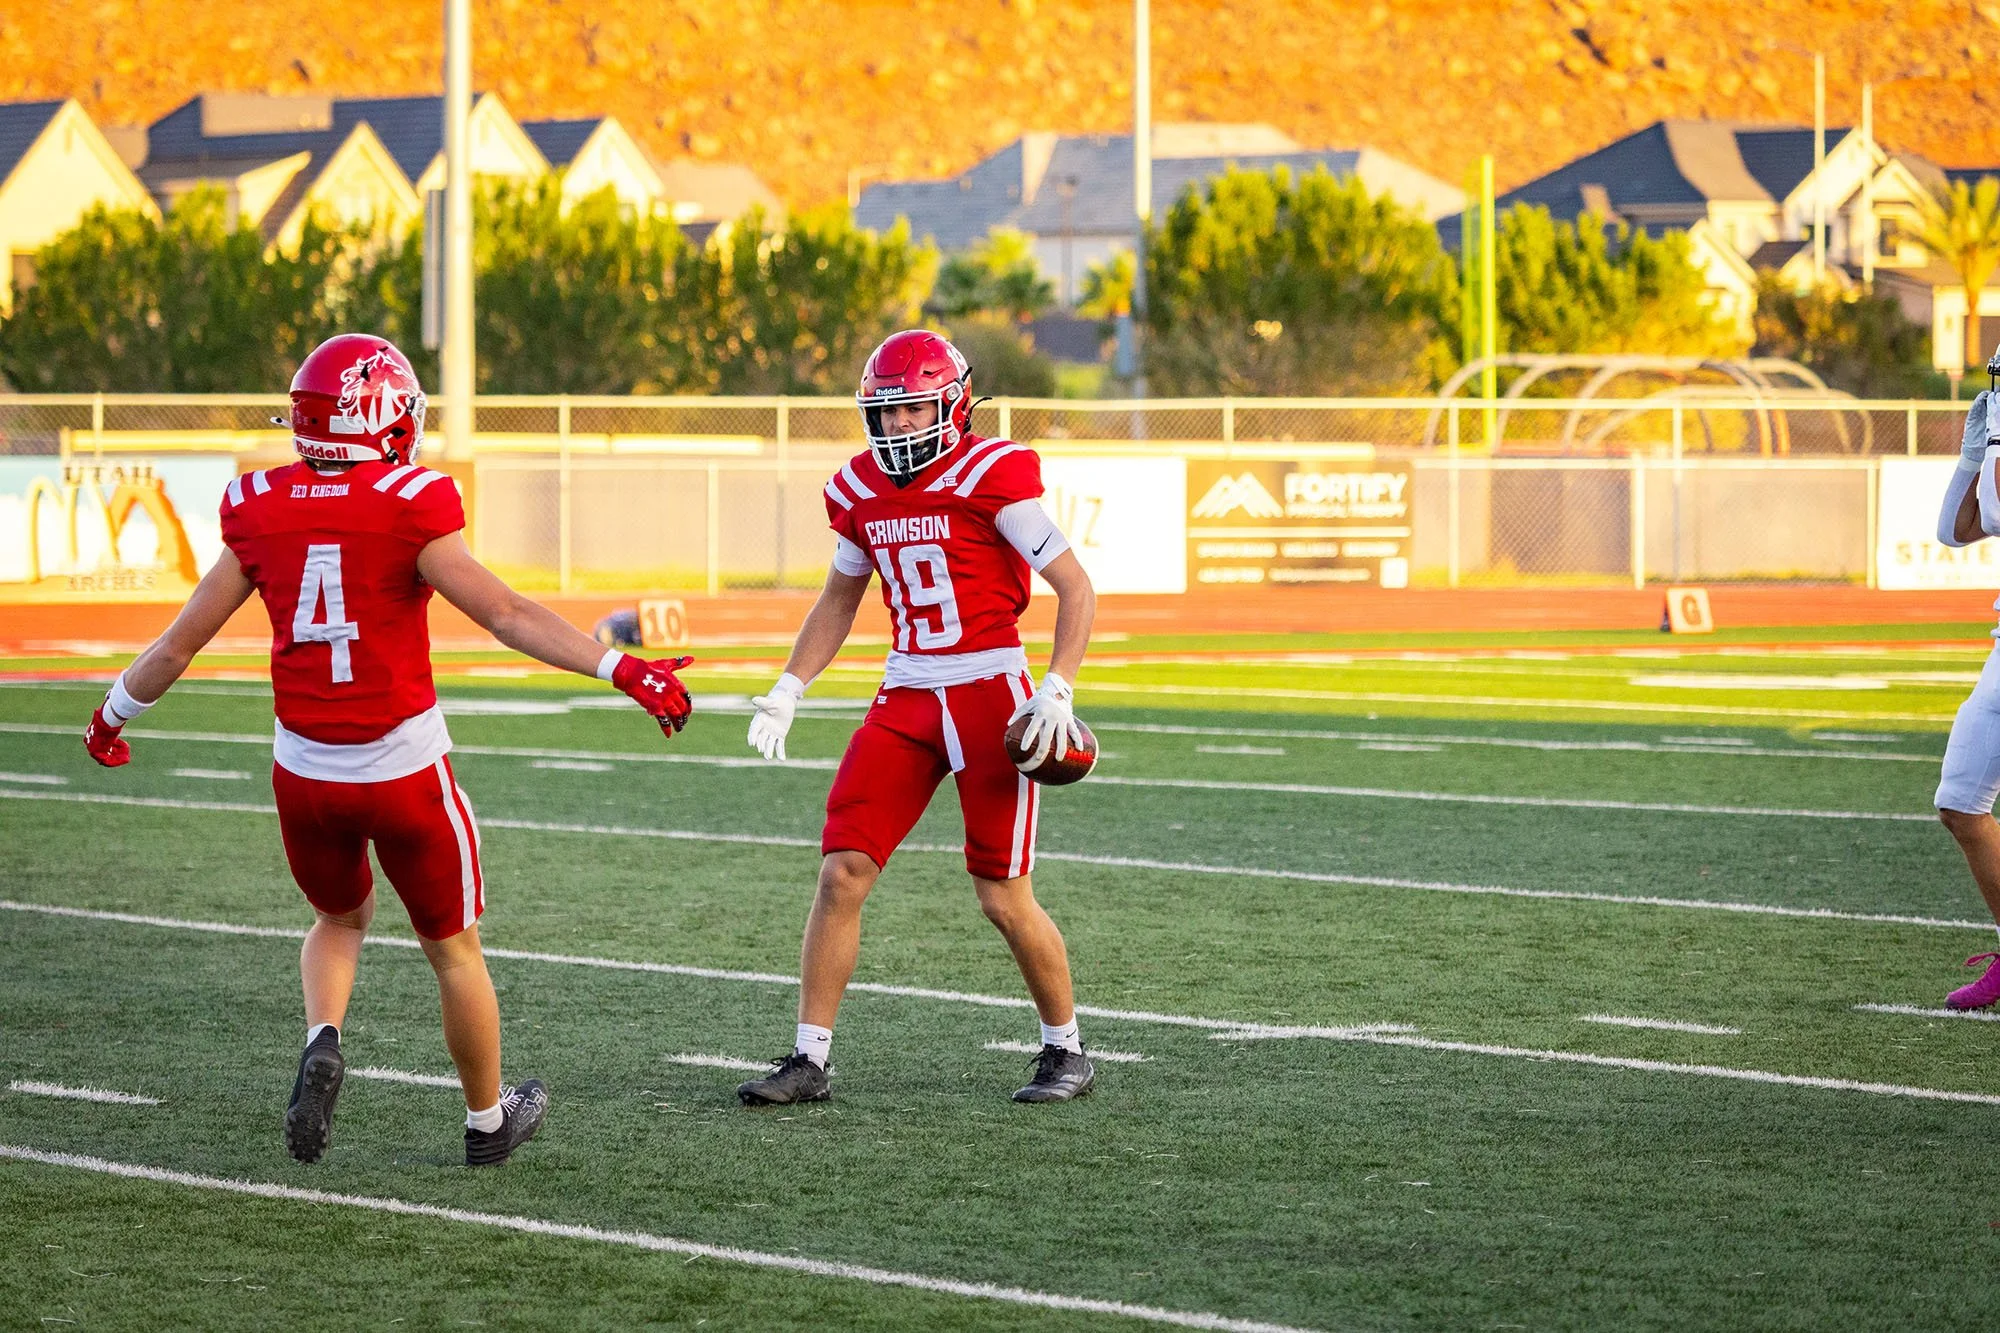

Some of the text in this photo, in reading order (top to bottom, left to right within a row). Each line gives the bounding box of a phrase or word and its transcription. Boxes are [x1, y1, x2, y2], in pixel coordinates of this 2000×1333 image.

[875, 386, 903, 396] Riddell
[295, 440, 349, 460] Riddell
[64, 466, 153, 486] UTAH
[290, 483, 350, 499] RED KINGDOM
[1284, 473, 1408, 503] FORTIFY
[865, 514, 951, 546] CRIMSON
[874, 543, 963, 651] 19
[1681, 594, 1702, 626] G
[292, 544, 360, 683] 4
[646, 607, 683, 641] 10
